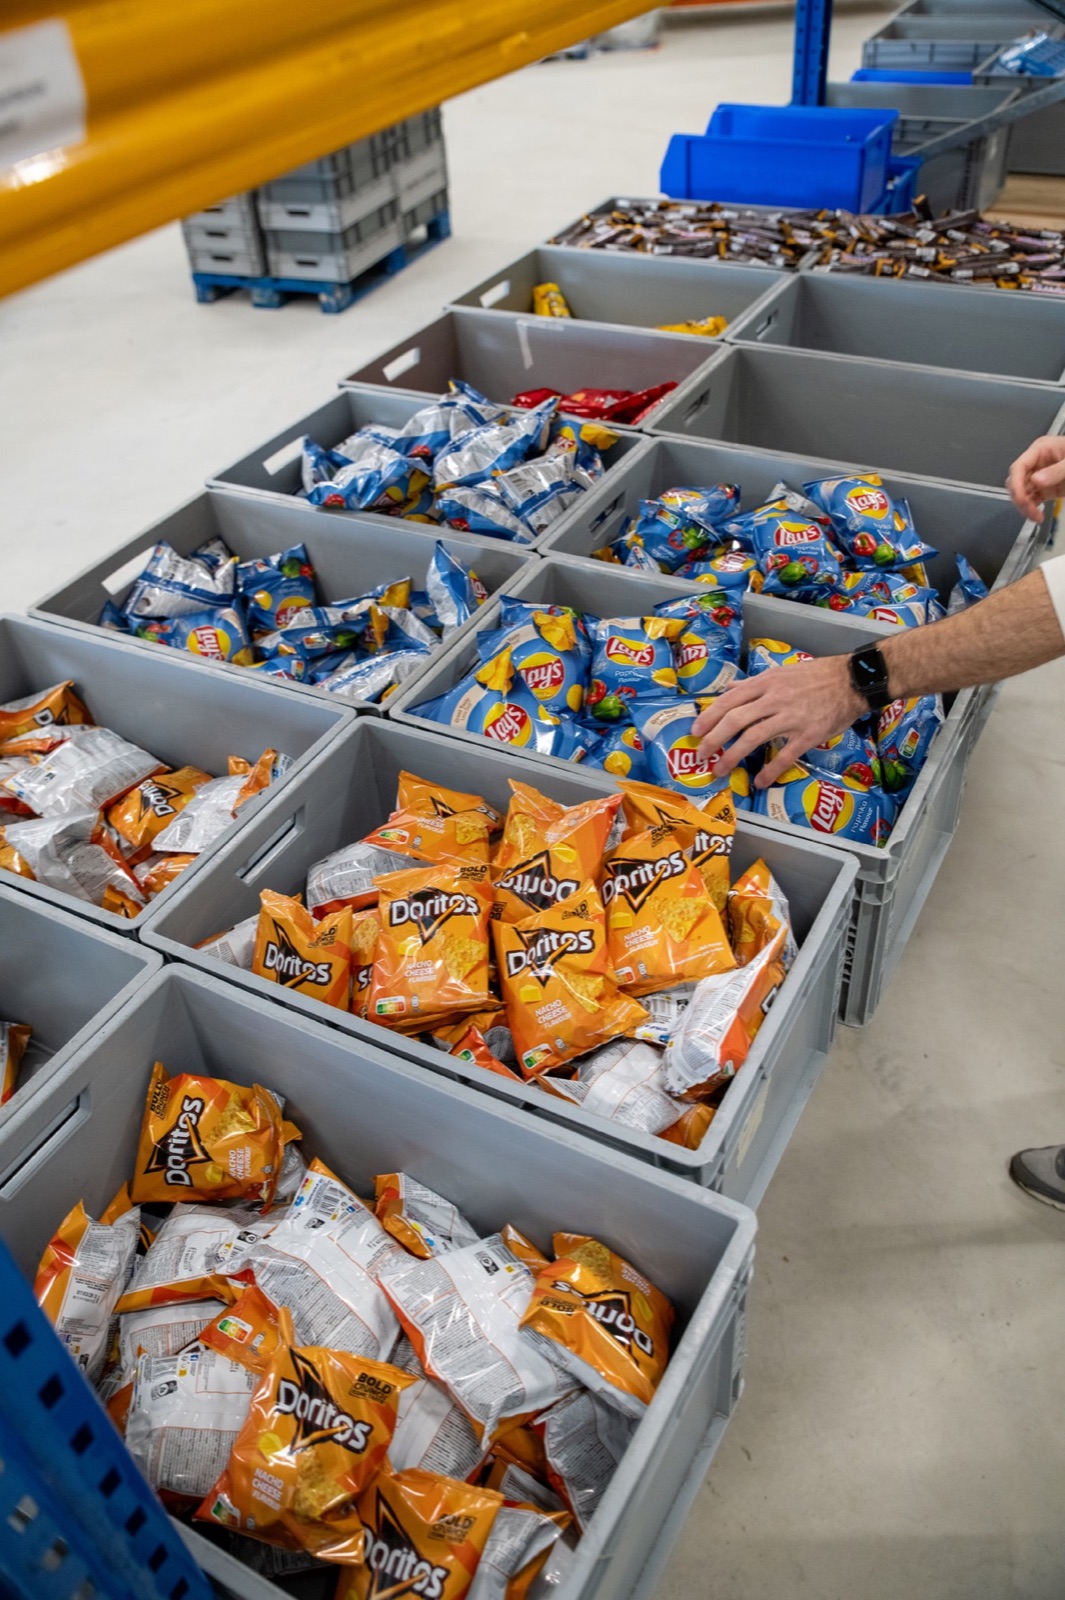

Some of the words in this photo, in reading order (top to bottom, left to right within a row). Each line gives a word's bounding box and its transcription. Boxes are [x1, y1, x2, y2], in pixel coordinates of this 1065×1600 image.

[777, 524, 819, 546] Lay's
[605, 637, 654, 666] Lay's
[811, 779, 846, 832] Lay's
[851, 800, 868, 833] Paprika
[859, 807, 873, 832] Flavour
[695, 831, 735, 854] itos
[601, 850, 687, 906] Doritos
[391, 893, 480, 927] Doritos
[624, 924, 651, 942] NACHO
[625, 932, 656, 949] CHEESE
[264, 942, 332, 986] Doritos
[405, 959, 433, 970] NACHO
[507, 929, 594, 978] Doritos
[405, 967, 436, 978] CHEESE
[535, 999, 563, 1017] NACHO
[538, 1006, 568, 1025] CHEESE
[544, 1012, 573, 1030] FLAVOUR
[155, 1085, 170, 1116] CRUNCH
[166, 1098, 203, 1187] Doritos
[236, 1147, 245, 1179] CHEESE
[353, 1382, 388, 1399] CRUNCH
[358, 1372, 392, 1395] BOLD
[275, 1378, 373, 1453] Doritos
[252, 1478, 283, 1500] CHEESE
[255, 1467, 284, 1489] NACHO
